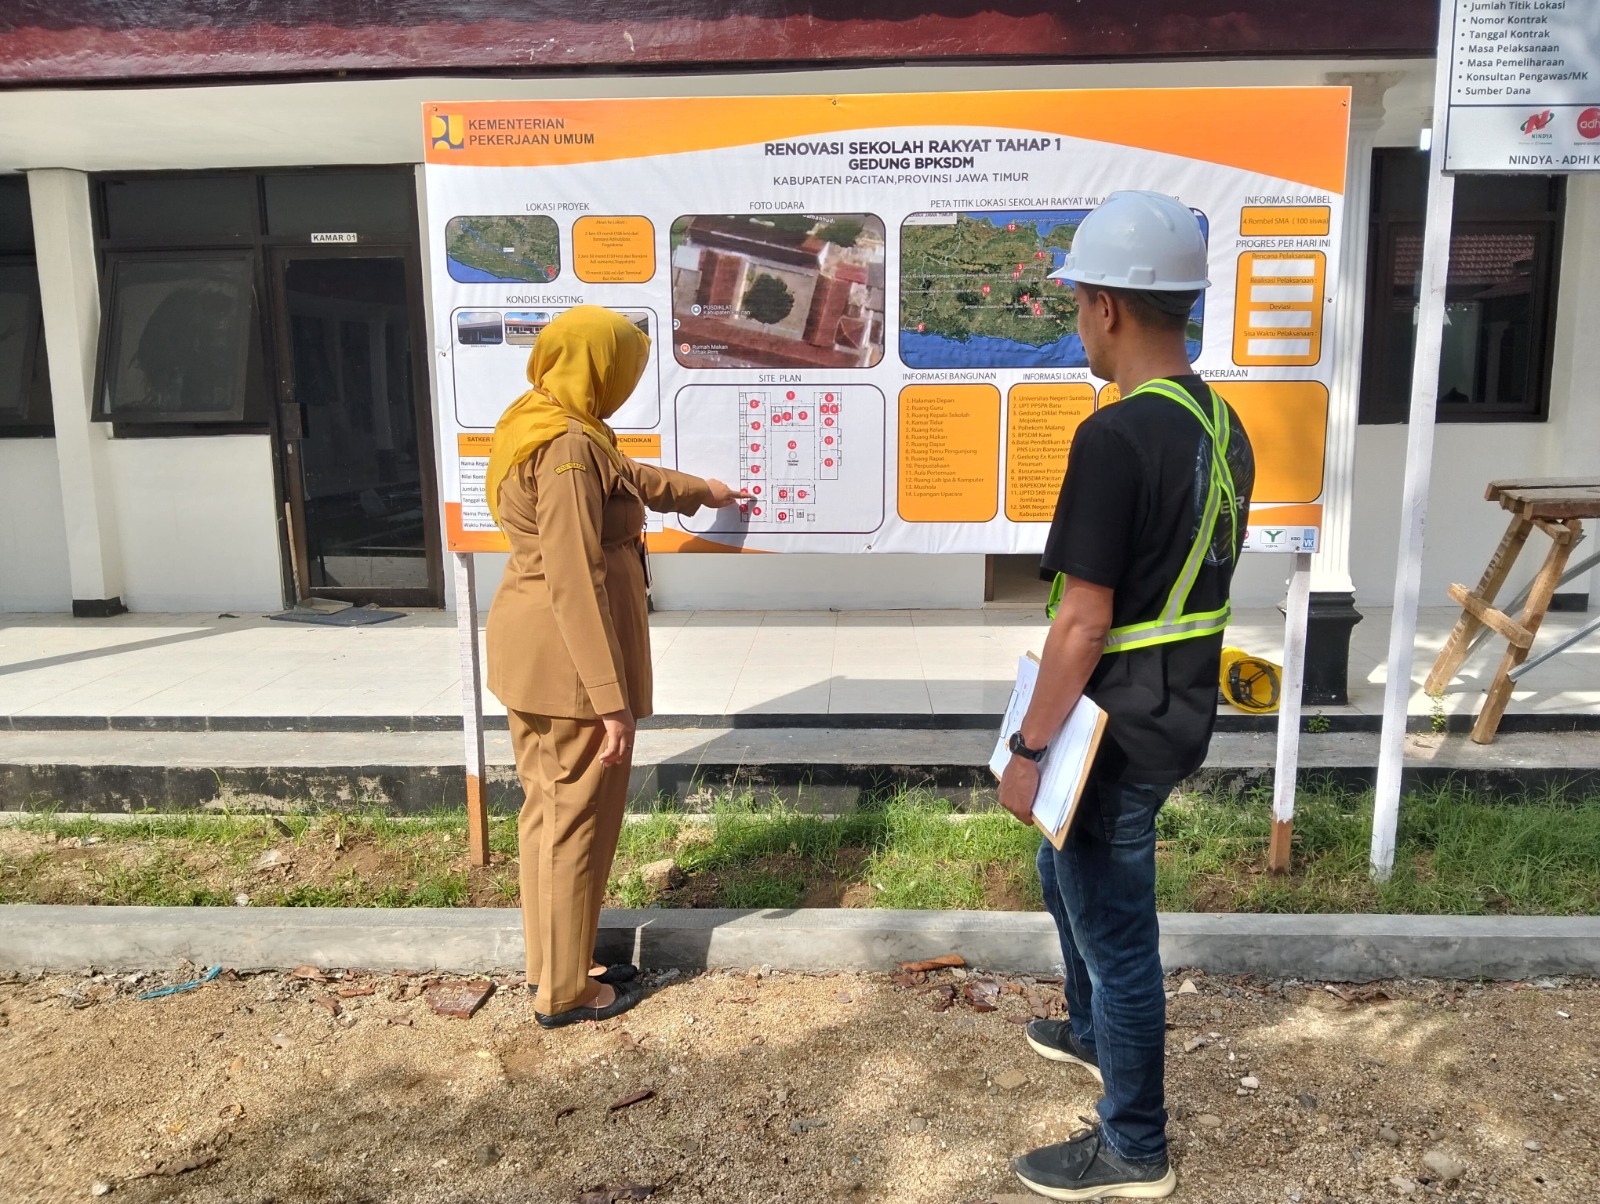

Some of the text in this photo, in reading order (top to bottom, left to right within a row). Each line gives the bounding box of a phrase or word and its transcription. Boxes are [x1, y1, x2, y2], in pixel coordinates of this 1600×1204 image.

[1470, 0, 1566, 12] Jumlah Titik Lokasi
[1508, 16, 1548, 24] Kontrak
[1470, 30, 1550, 40] Tanggal Kontrak
[1468, 44, 1560, 53] Masa Pelaksanaan
[1468, 58, 1564, 67] Masa Pemeliharaan
[1466, 72, 1588, 82] Konsultan Pengawas/MK
[1465, 86, 1531, 95] Sumber Dana
[468, 118, 565, 130] KEMENTERIAN
[469, 134, 594, 146] PEKERJAAN UMUM
[764, 138, 1061, 156] RENOVASI SEKOLAH RAKYAT TAHAP 1
[848, 156, 974, 170] GEDUNG BPKSDM
[1509, 155, 1552, 165] NINDYA
[1562, 155, 1590, 164] ADHI
[774, 176, 842, 186] KABUPATEN
[956, 173, 988, 183] JAWA
[992, 172, 1028, 182] TIMUR
[930, 200, 951, 208] PETA
[953, 200, 974, 208] TITIK
[976, 199, 1006, 207] LOKASI
[1008, 198, 1048, 206] SEKOLAH
[1050, 198, 1082, 206] RAKYAT
[1244, 196, 1332, 204] INFORMASI ROMBEL
[526, 202, 590, 211] LOKASI PROYEK
[749, 201, 804, 210] FOTO UDARA
[1236, 239, 1331, 248] PROGRES PER HARI INI
[506, 296, 584, 304] KONDISI EKSISTING
[1200, 370, 1248, 378] PEKERJAAN
